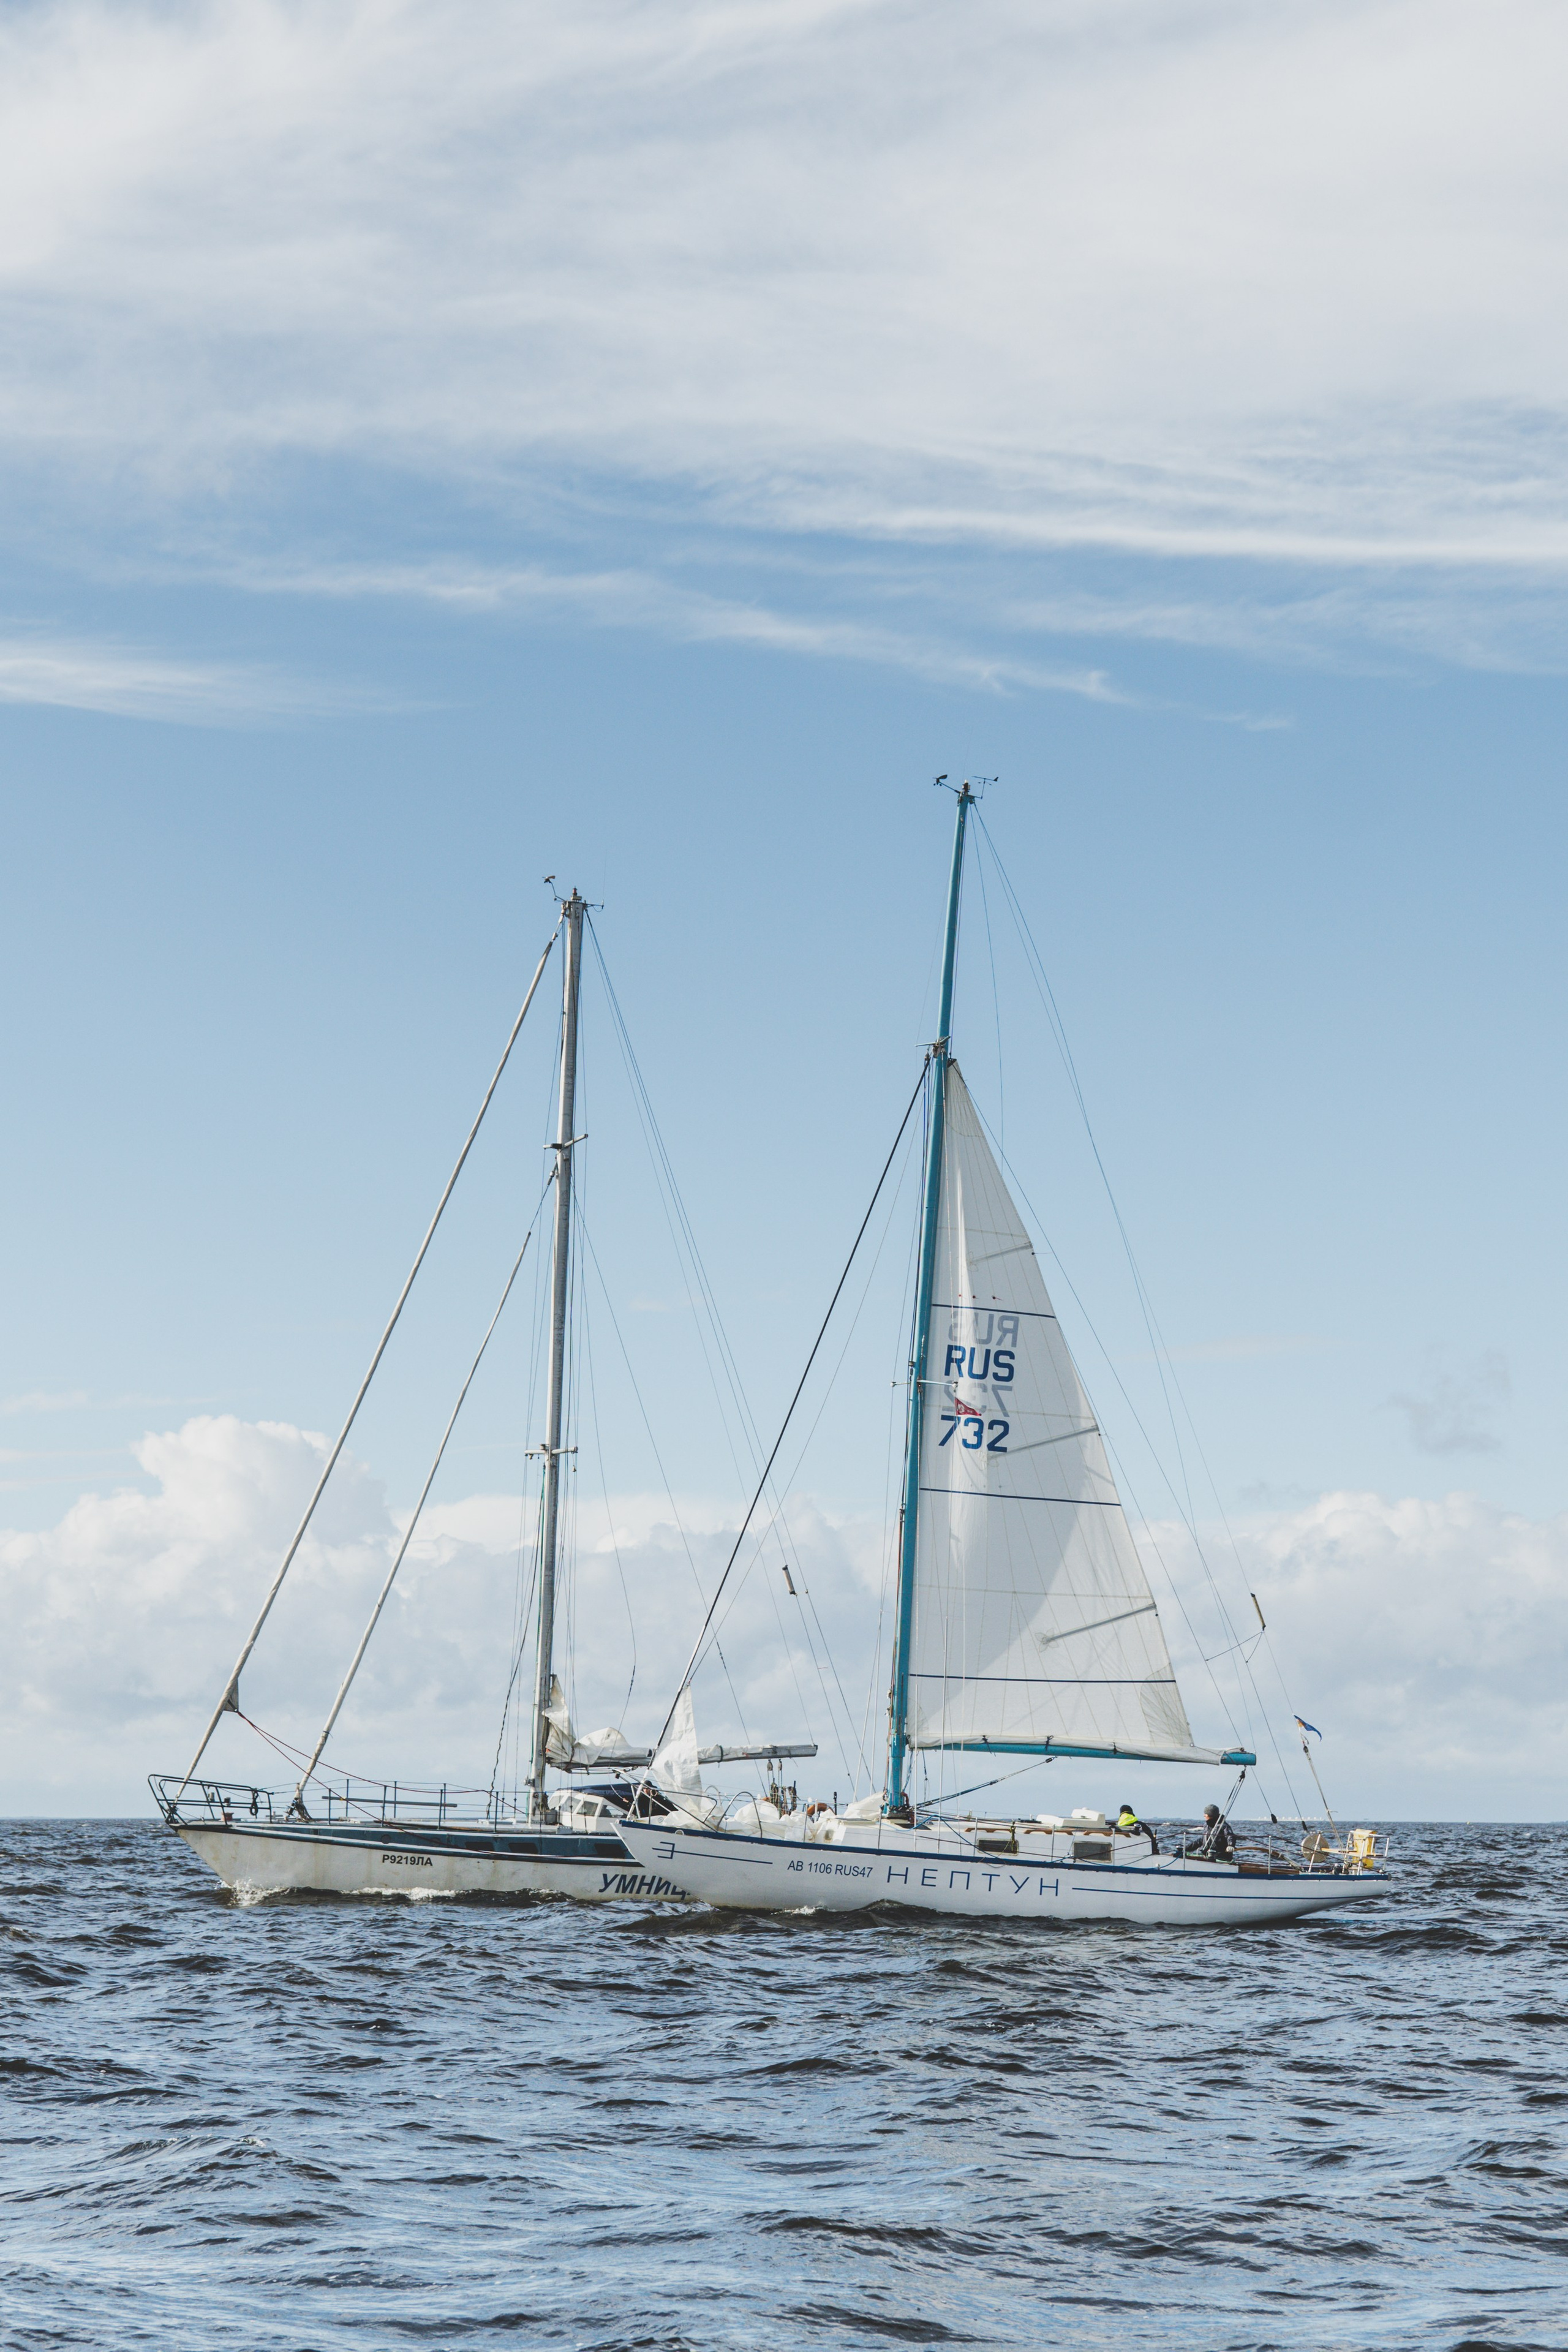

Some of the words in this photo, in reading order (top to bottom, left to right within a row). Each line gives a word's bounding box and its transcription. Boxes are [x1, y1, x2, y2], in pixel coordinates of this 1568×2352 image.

[944, 1344, 1015, 1382] RUS
[938, 1414, 1009, 1452] 732
[382, 1854, 433, 1866] Р9219ЛА
[808, 1862, 832, 1874] 1106
[835, 1864, 873, 1878] RUS47
[598, 1873, 691, 1901] УМНИЦ
[887, 1865, 1058, 1896] НЕПТУН
